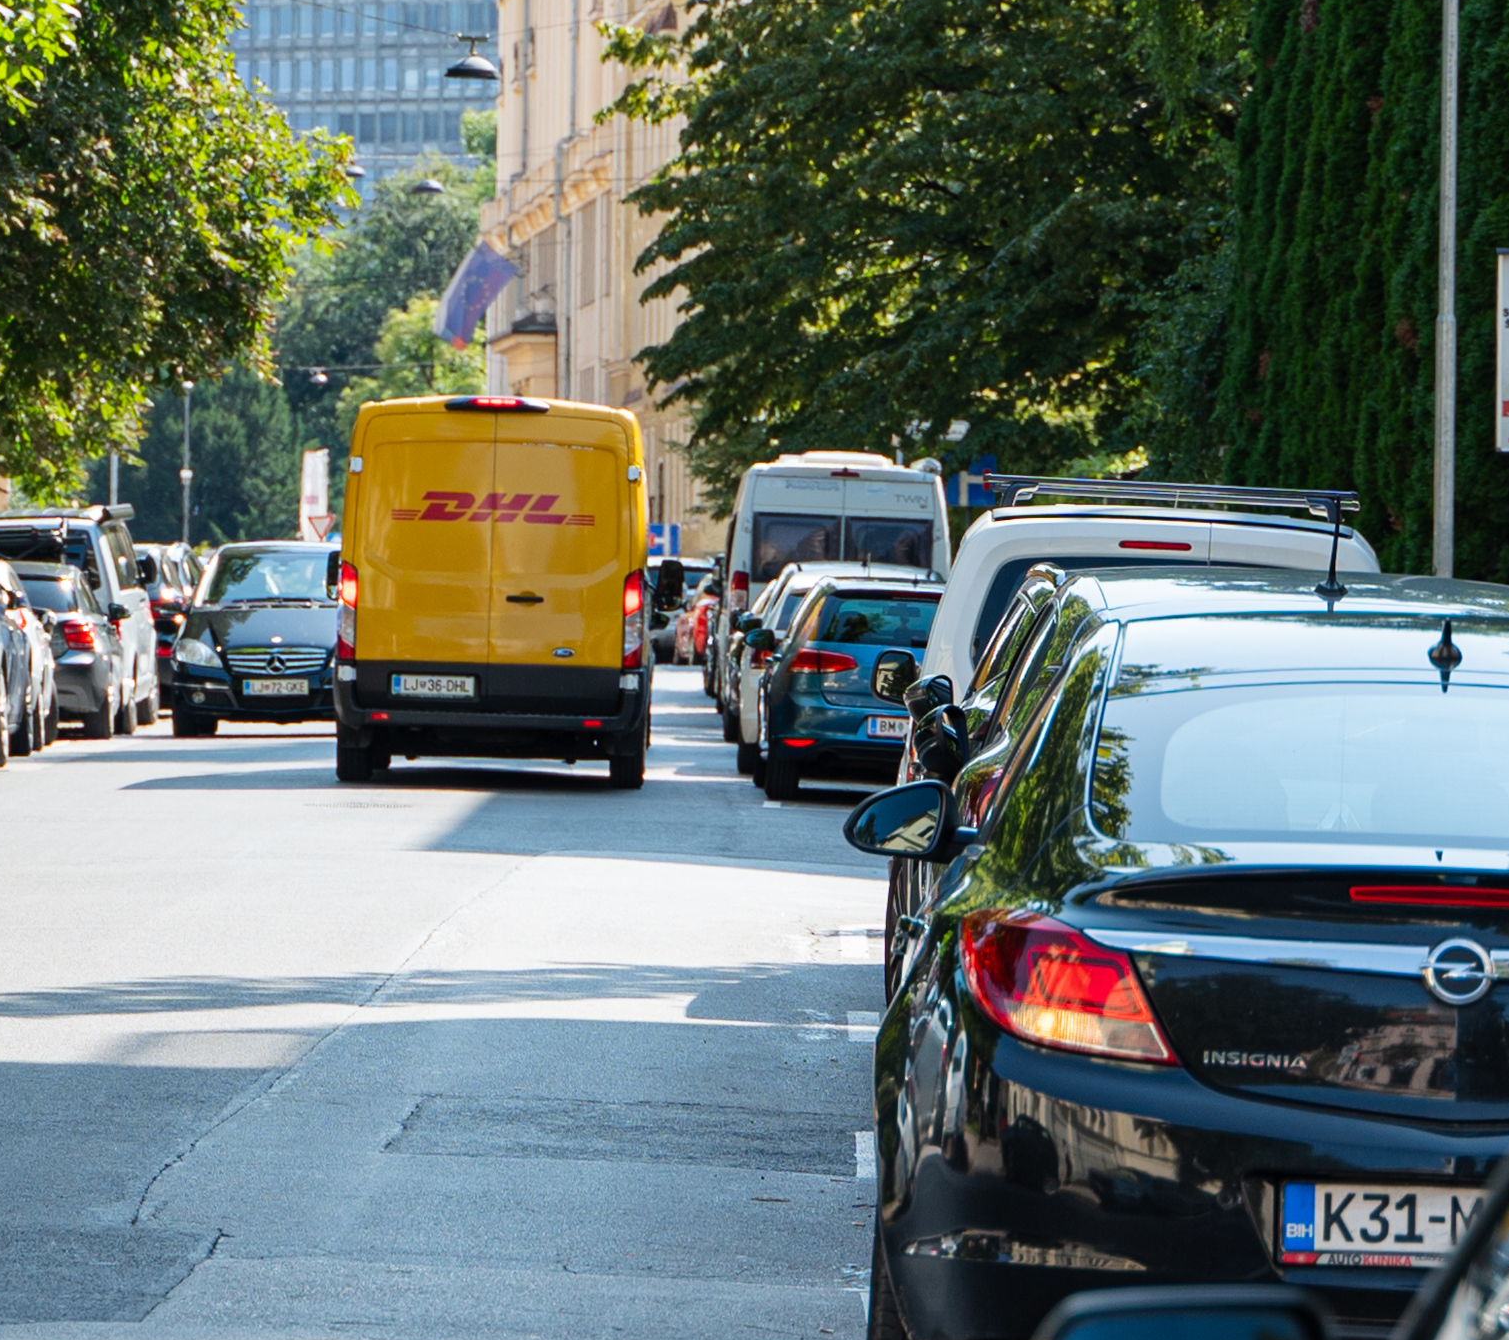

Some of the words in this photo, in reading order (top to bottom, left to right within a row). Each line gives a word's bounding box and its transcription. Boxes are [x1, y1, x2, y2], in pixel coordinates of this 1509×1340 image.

[894, 494, 929, 504] TWIN
[419, 490, 568, 525] DHL
[252, 682, 264, 693] LJ
[404, 679, 419, 691] LJ
[427, 679, 470, 692] 36-DHL
[1203, 1050, 1308, 1070] INSIGNIA
[1285, 1223, 1314, 1238] BIH
